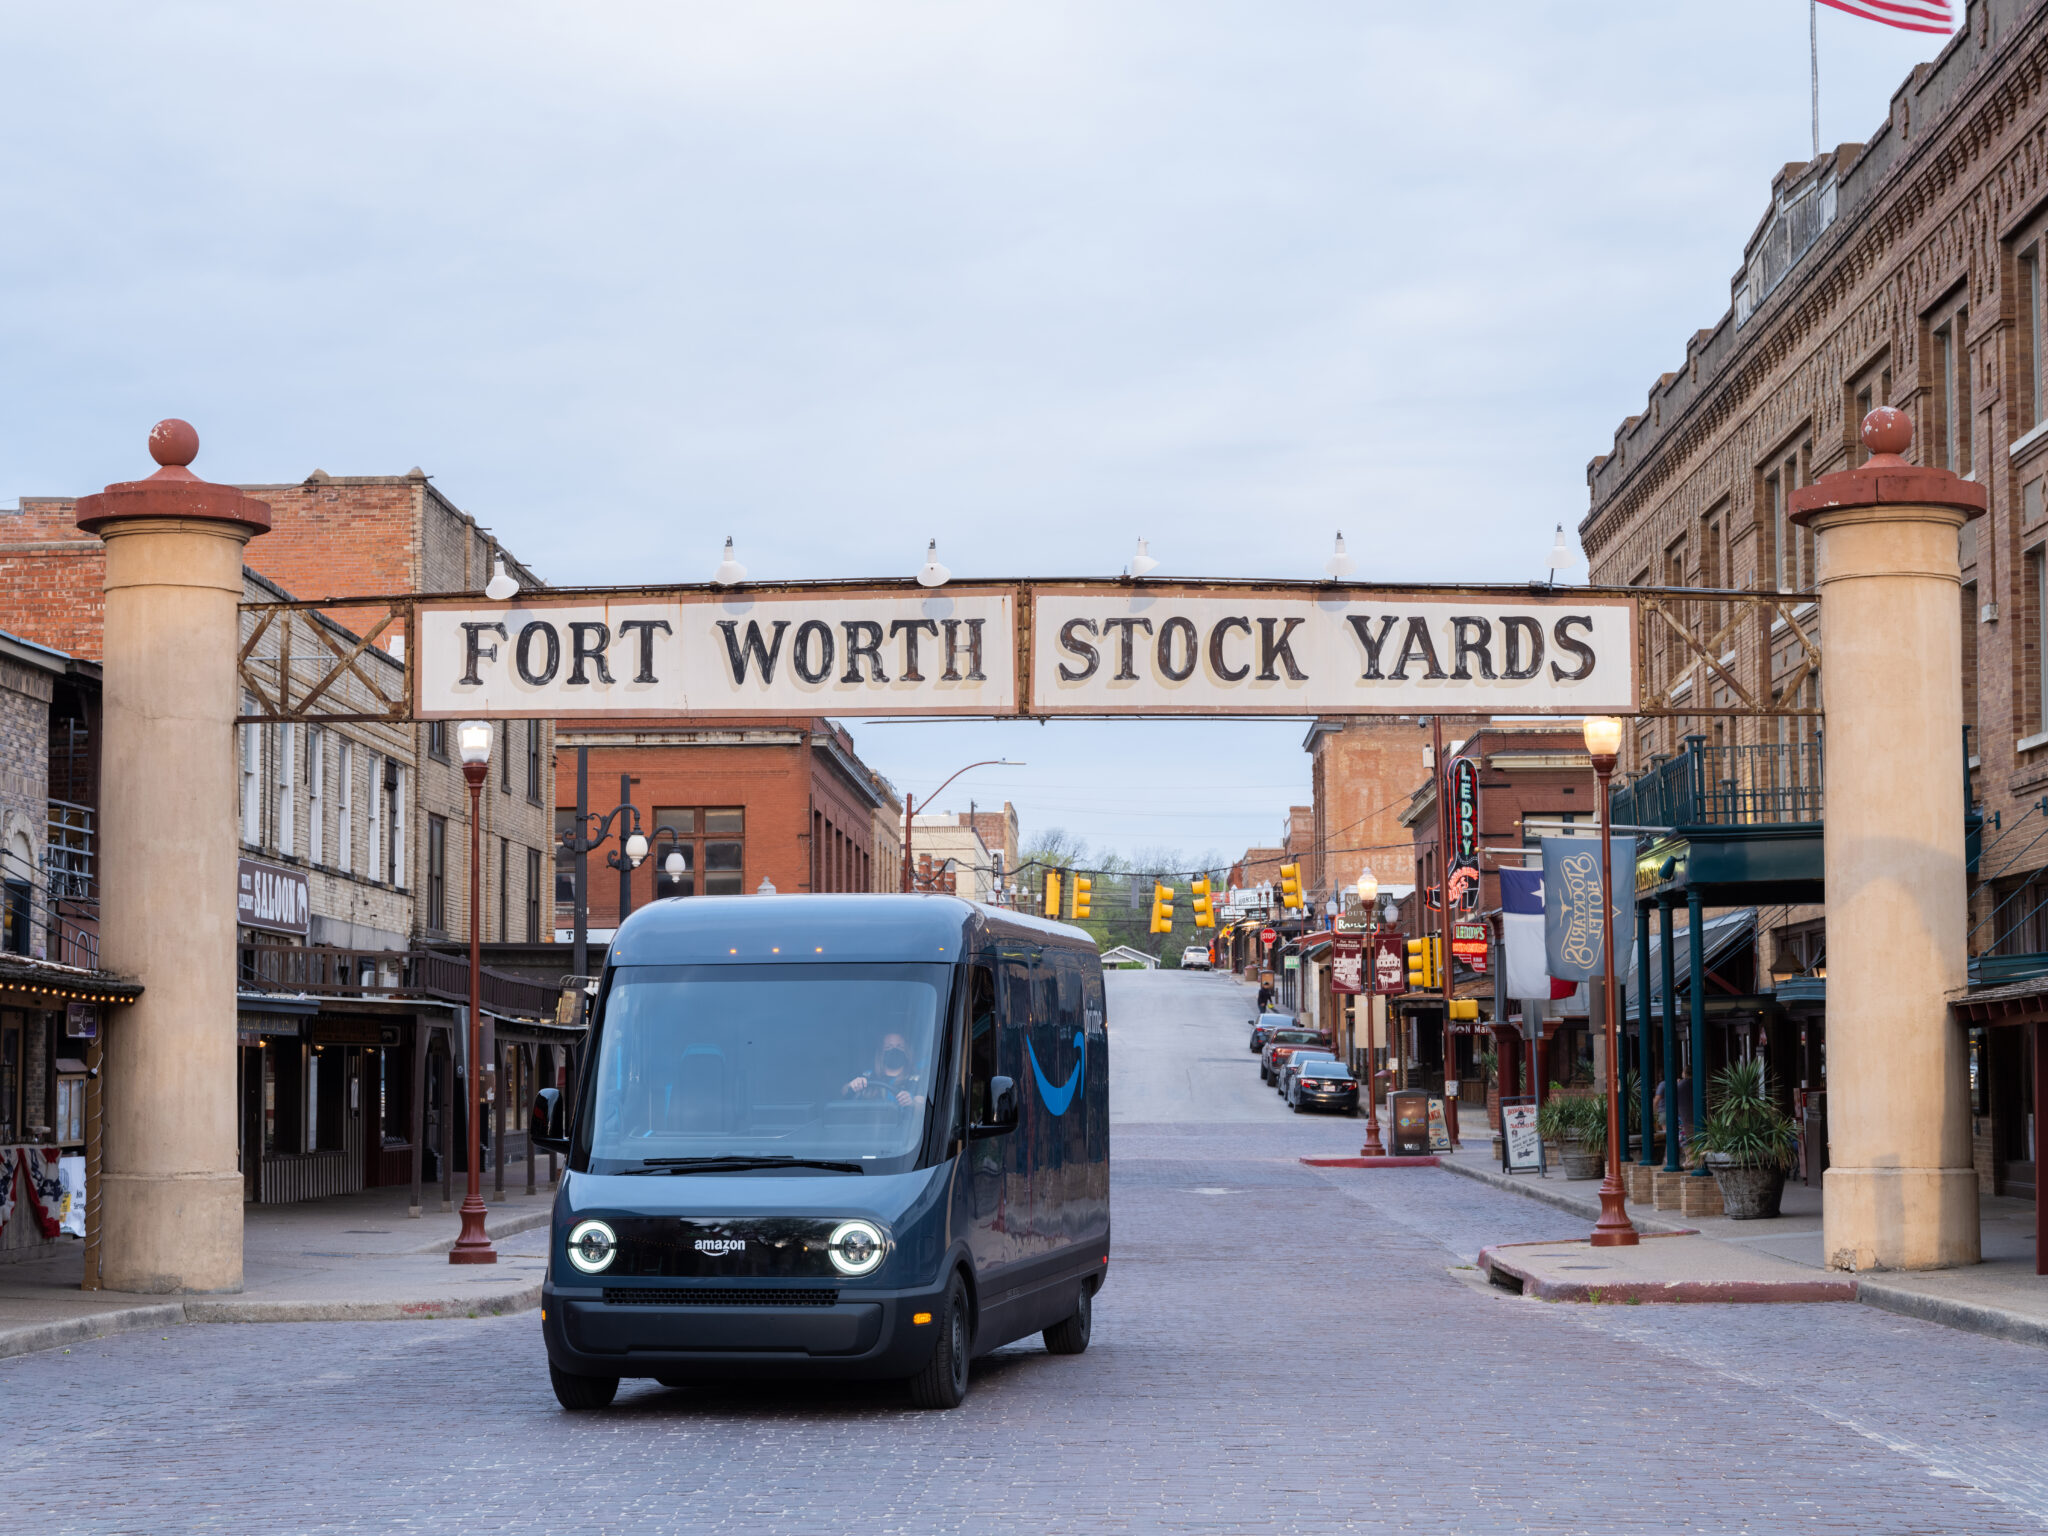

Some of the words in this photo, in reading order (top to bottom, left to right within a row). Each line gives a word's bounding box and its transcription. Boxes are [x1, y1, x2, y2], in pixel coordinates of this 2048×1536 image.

[459, 619, 672, 686] FORT
[716, 617, 988, 685] WORTH
[1058, 615, 1308, 681] STOCK
[1346, 615, 1596, 682] YARDS
[1461, 764, 1473, 856] LEDDY
[254, 871, 296, 924] SALOON
[1455, 925, 1485, 940] LEDDY'S
[694, 1239, 746, 1250] amazon
